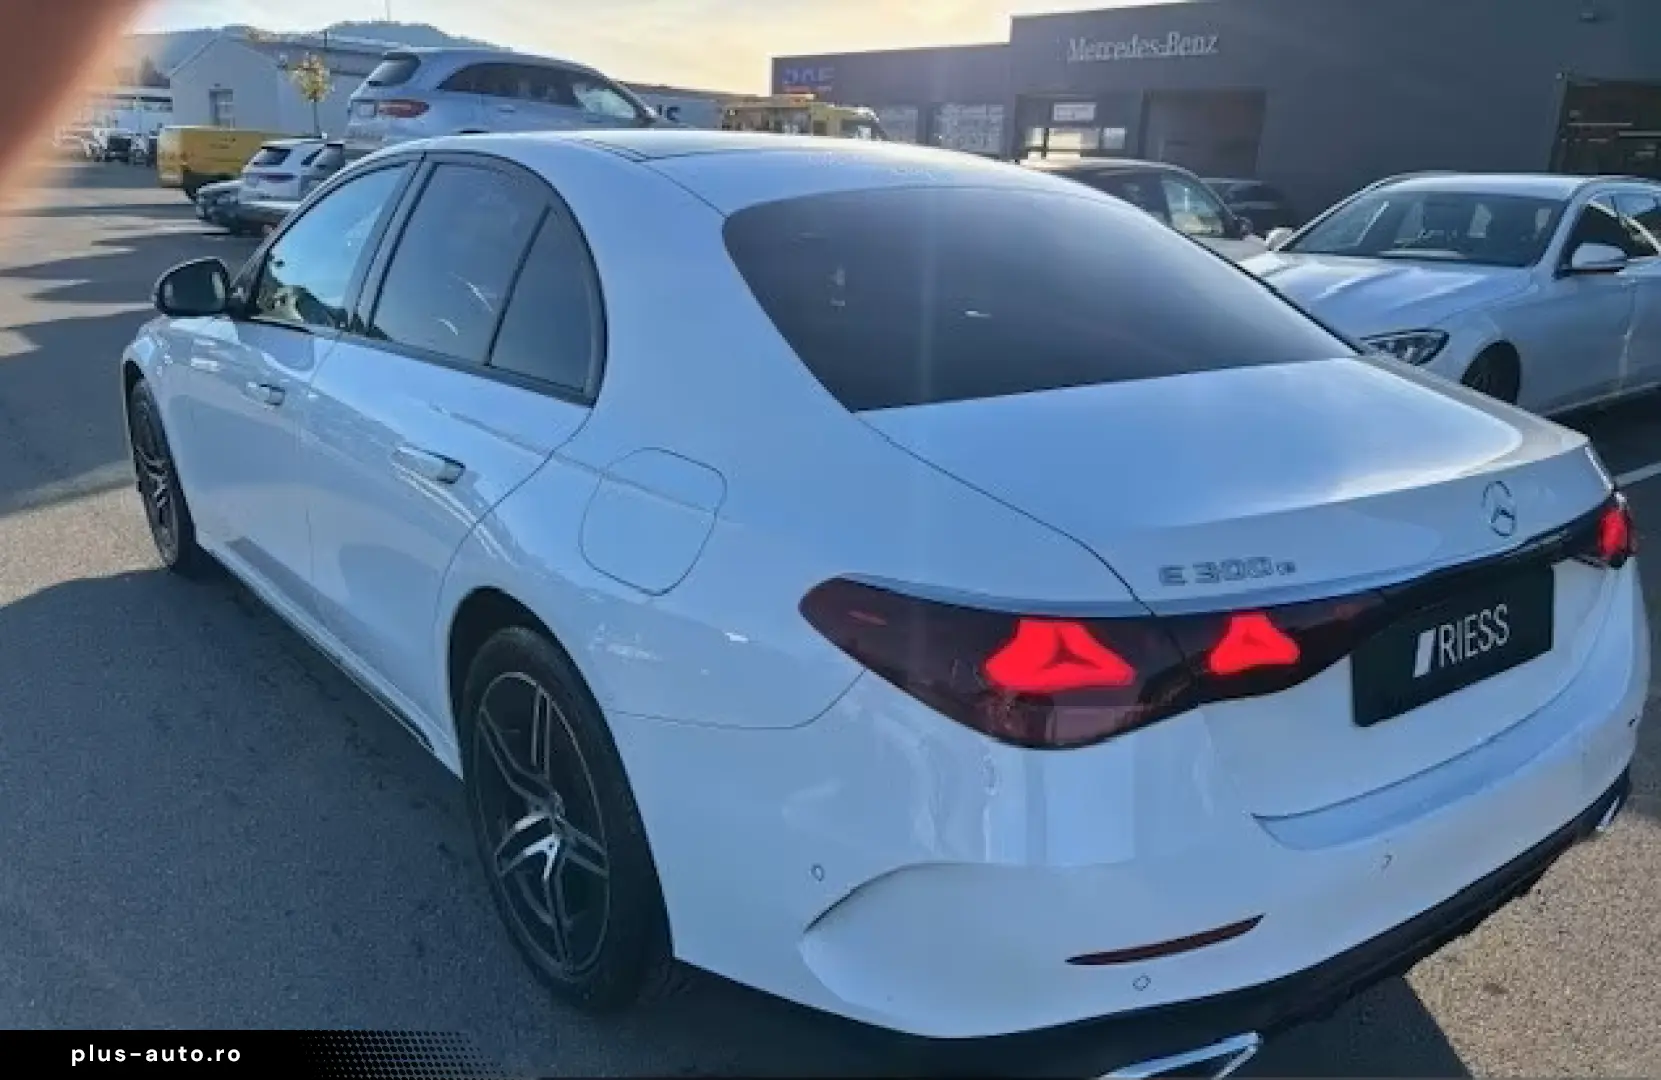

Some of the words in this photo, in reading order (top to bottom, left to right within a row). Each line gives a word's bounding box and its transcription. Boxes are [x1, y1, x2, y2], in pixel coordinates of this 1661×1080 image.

[1067, 31, 1219, 63] Mercedes-Benz
[1159, 564, 1187, 586] E
[1440, 603, 1510, 668] RIESS
